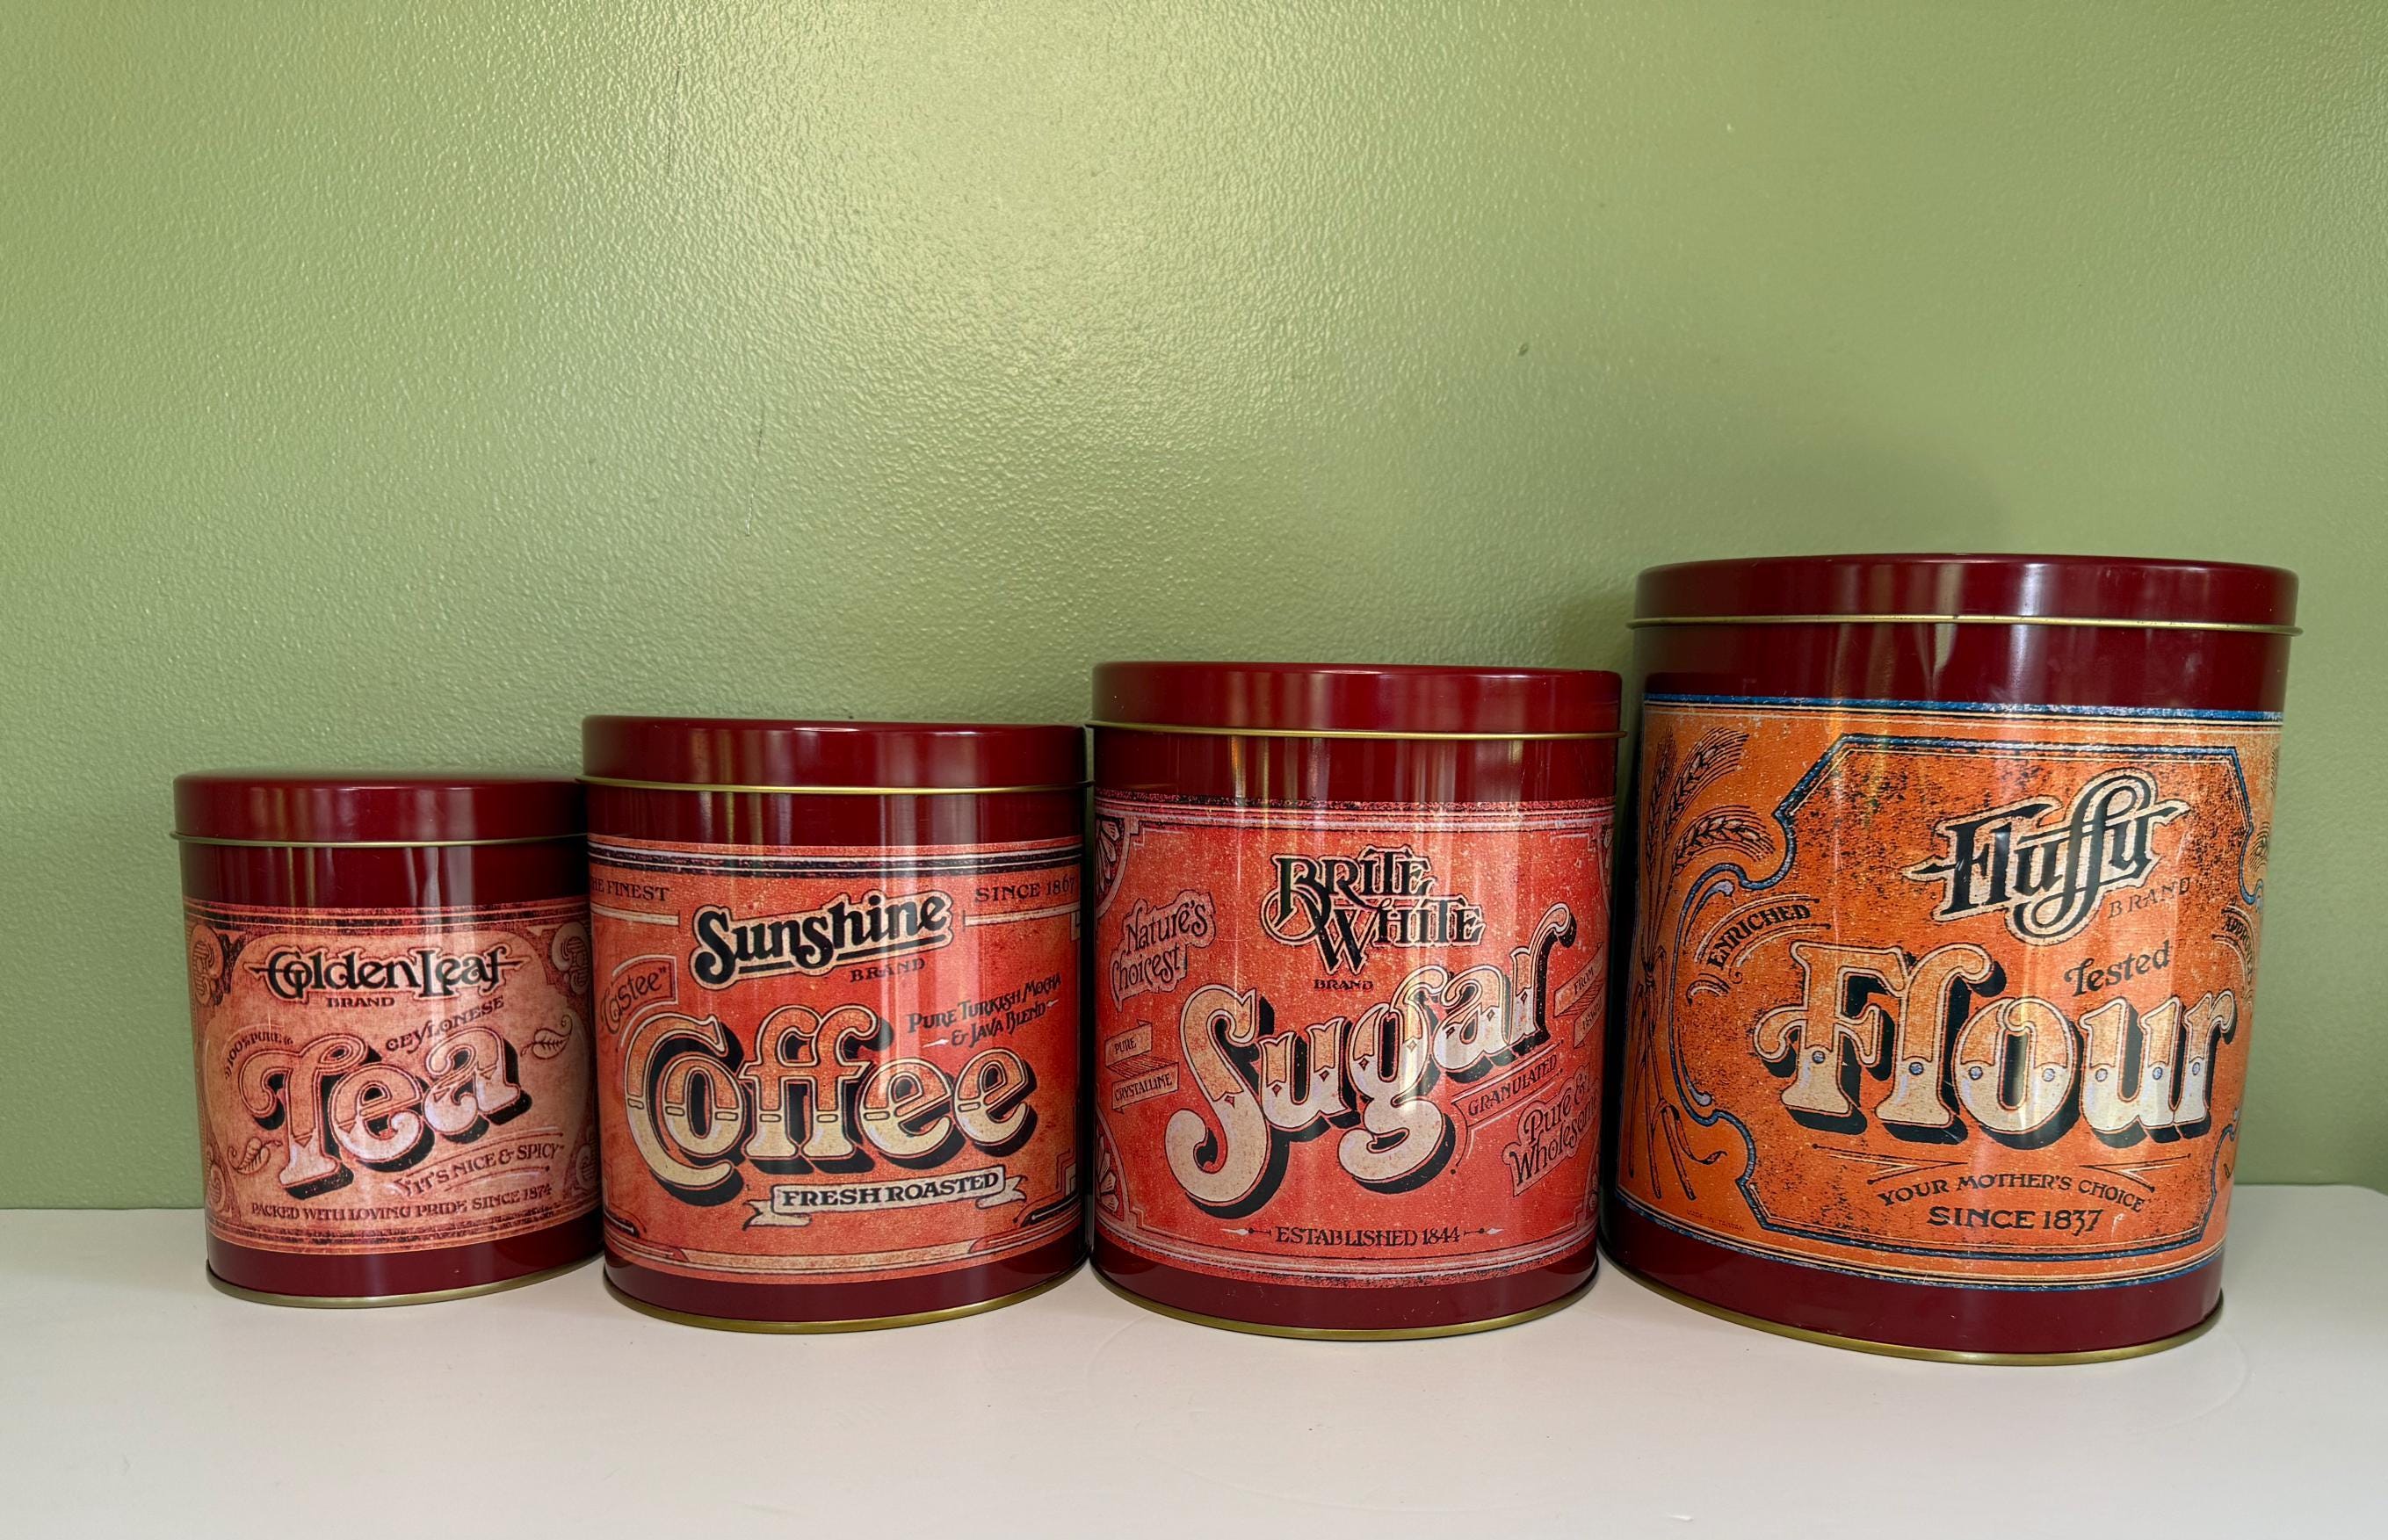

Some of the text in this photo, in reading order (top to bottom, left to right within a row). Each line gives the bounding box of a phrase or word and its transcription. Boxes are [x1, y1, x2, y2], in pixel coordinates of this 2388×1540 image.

[1907, 772, 2186, 941] Fluffy
[606, 880, 669, 902] FINEST
[974, 872, 1076, 903] SINCE 1867
[1263, 845, 1437, 944] BRITE
[2108, 876, 2191, 919] BRAND
[691, 892, 950, 987] Sunshine
[1125, 900, 1208, 955] Nature's
[1316, 896, 1486, 973] WHITE
[1706, 904, 1812, 971] ENRICHED
[264, 945, 508, 1000] Golden Leaf
[850, 958, 927, 983] BRAND
[1111, 942, 1180, 1002] Choicest
[1313, 978, 1374, 991] BRAND
[1574, 966, 1595, 995] FROM
[2065, 938, 2171, 997] Tested
[326, 996, 396, 1009] BRAND
[385, 994, 505, 1054] CEYLONESE
[907, 972, 1062, 1034] PURE TURKISH MOCHA
[951, 1000, 1047, 1049] & JAVA BLEND
[1114, 1036, 1137, 1055] PURE
[1165, 903, 1575, 1219] Sugar
[1755, 942, 2238, 1153] Flour
[239, 1026, 532, 1200] Tea
[625, 1004, 1038, 1207] Coffee
[1114, 1073, 1173, 1103] CRYSTALLINE
[1468, 1054, 1558, 1117] GRANULATED
[1523, 1072, 1588, 1146] Pure &
[452, 1151, 497, 1178] NICE
[498, 1148, 515, 1165] &
[781, 1172, 1000, 1207] FRESH ROASTED
[250, 1182, 554, 1221] PACKED WITH LOVING PRIDE SINCE 1874
[1877, 1173, 2146, 1213] YOUR MOTHER'S CHOICE
[1275, 1225, 1461, 1247] ESTABLISHED 1844
[1926, 1205, 2104, 1237] SINCE 1837
